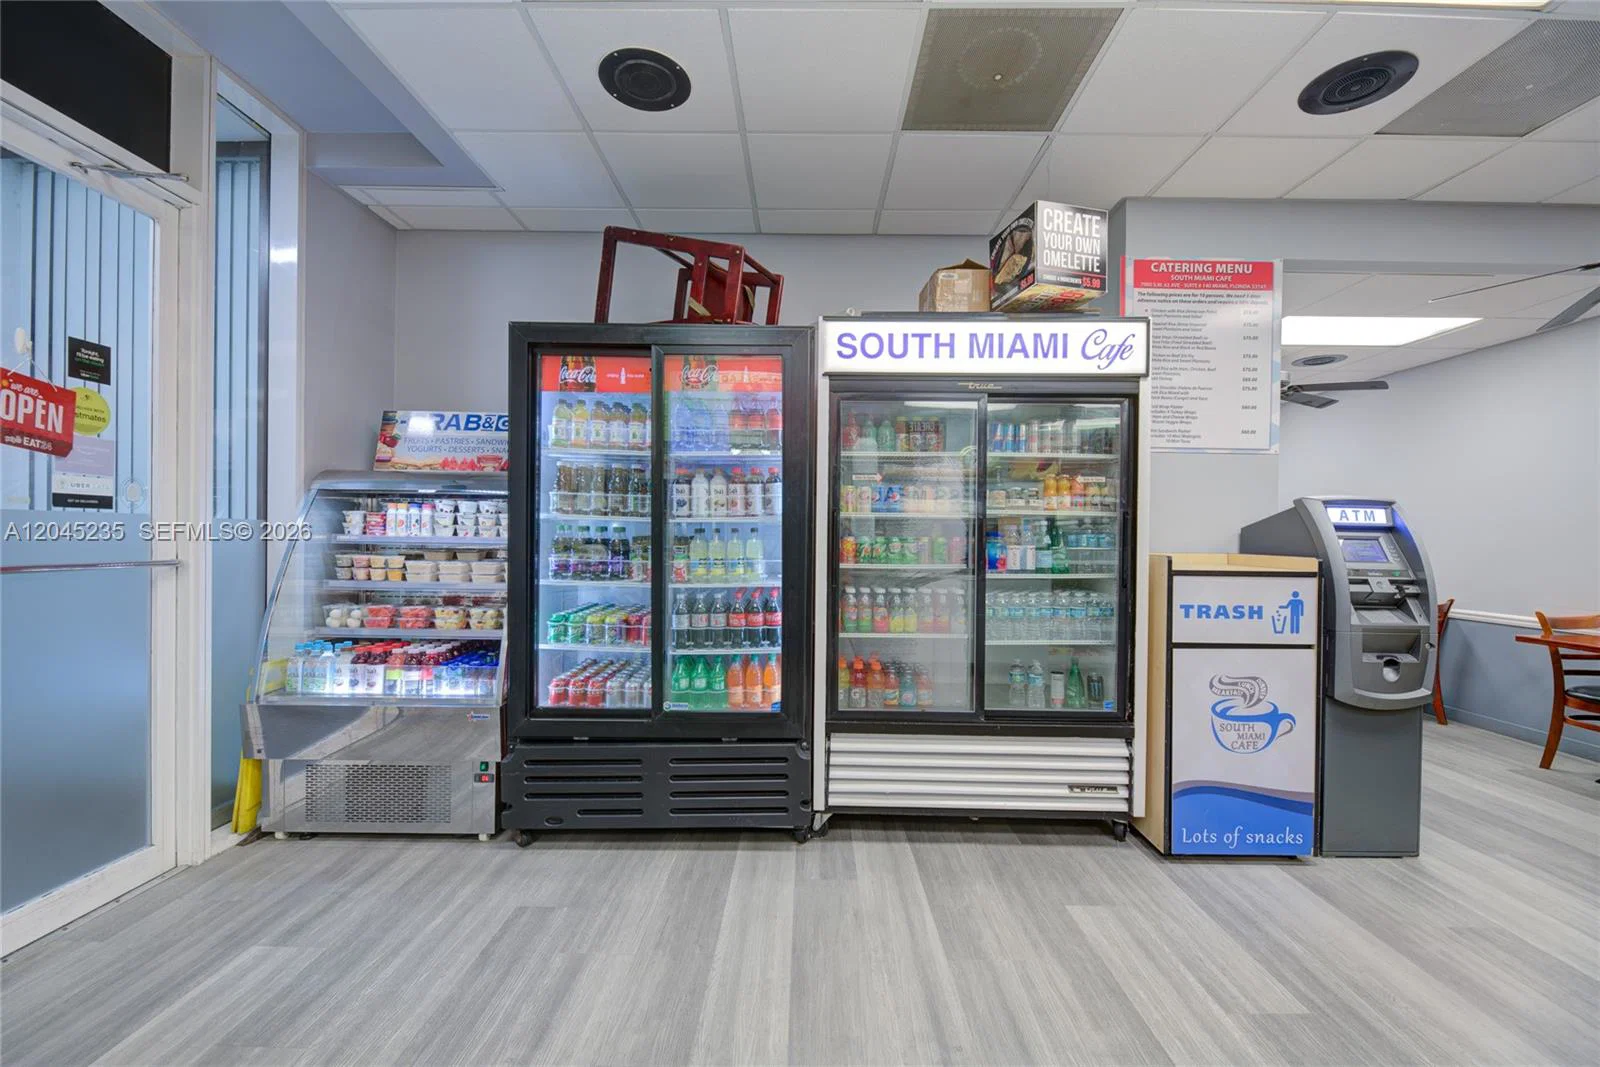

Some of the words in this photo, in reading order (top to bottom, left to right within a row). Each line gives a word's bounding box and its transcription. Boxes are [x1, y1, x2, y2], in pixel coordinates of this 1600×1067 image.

[1043, 208, 1101, 238] CREATE
[1043, 231, 1072, 252] YOUR
[1075, 236, 1101, 256] OWN
[1044, 250, 1101, 273] OMELETTE
[1151, 262, 1212, 273] CATERING
[1216, 264, 1253, 274] MENU
[836, 332, 956, 359] SOUTH
[968, 333, 1068, 359] MIAMI
[1080, 328, 1136, 370] Cafe
[0, 388, 64, 434] OPEN
[424, 413, 482, 431] RAB
[1340, 510, 1376, 522] ATM
[1179, 604, 1263, 620] TRASH
[1219, 723, 1255, 732] SOUTH
[1231, 740, 1258, 750] CAFE
[1182, 827, 1217, 845] Lots
[1223, 826, 1243, 849] of
[1246, 828, 1304, 845] snacks
